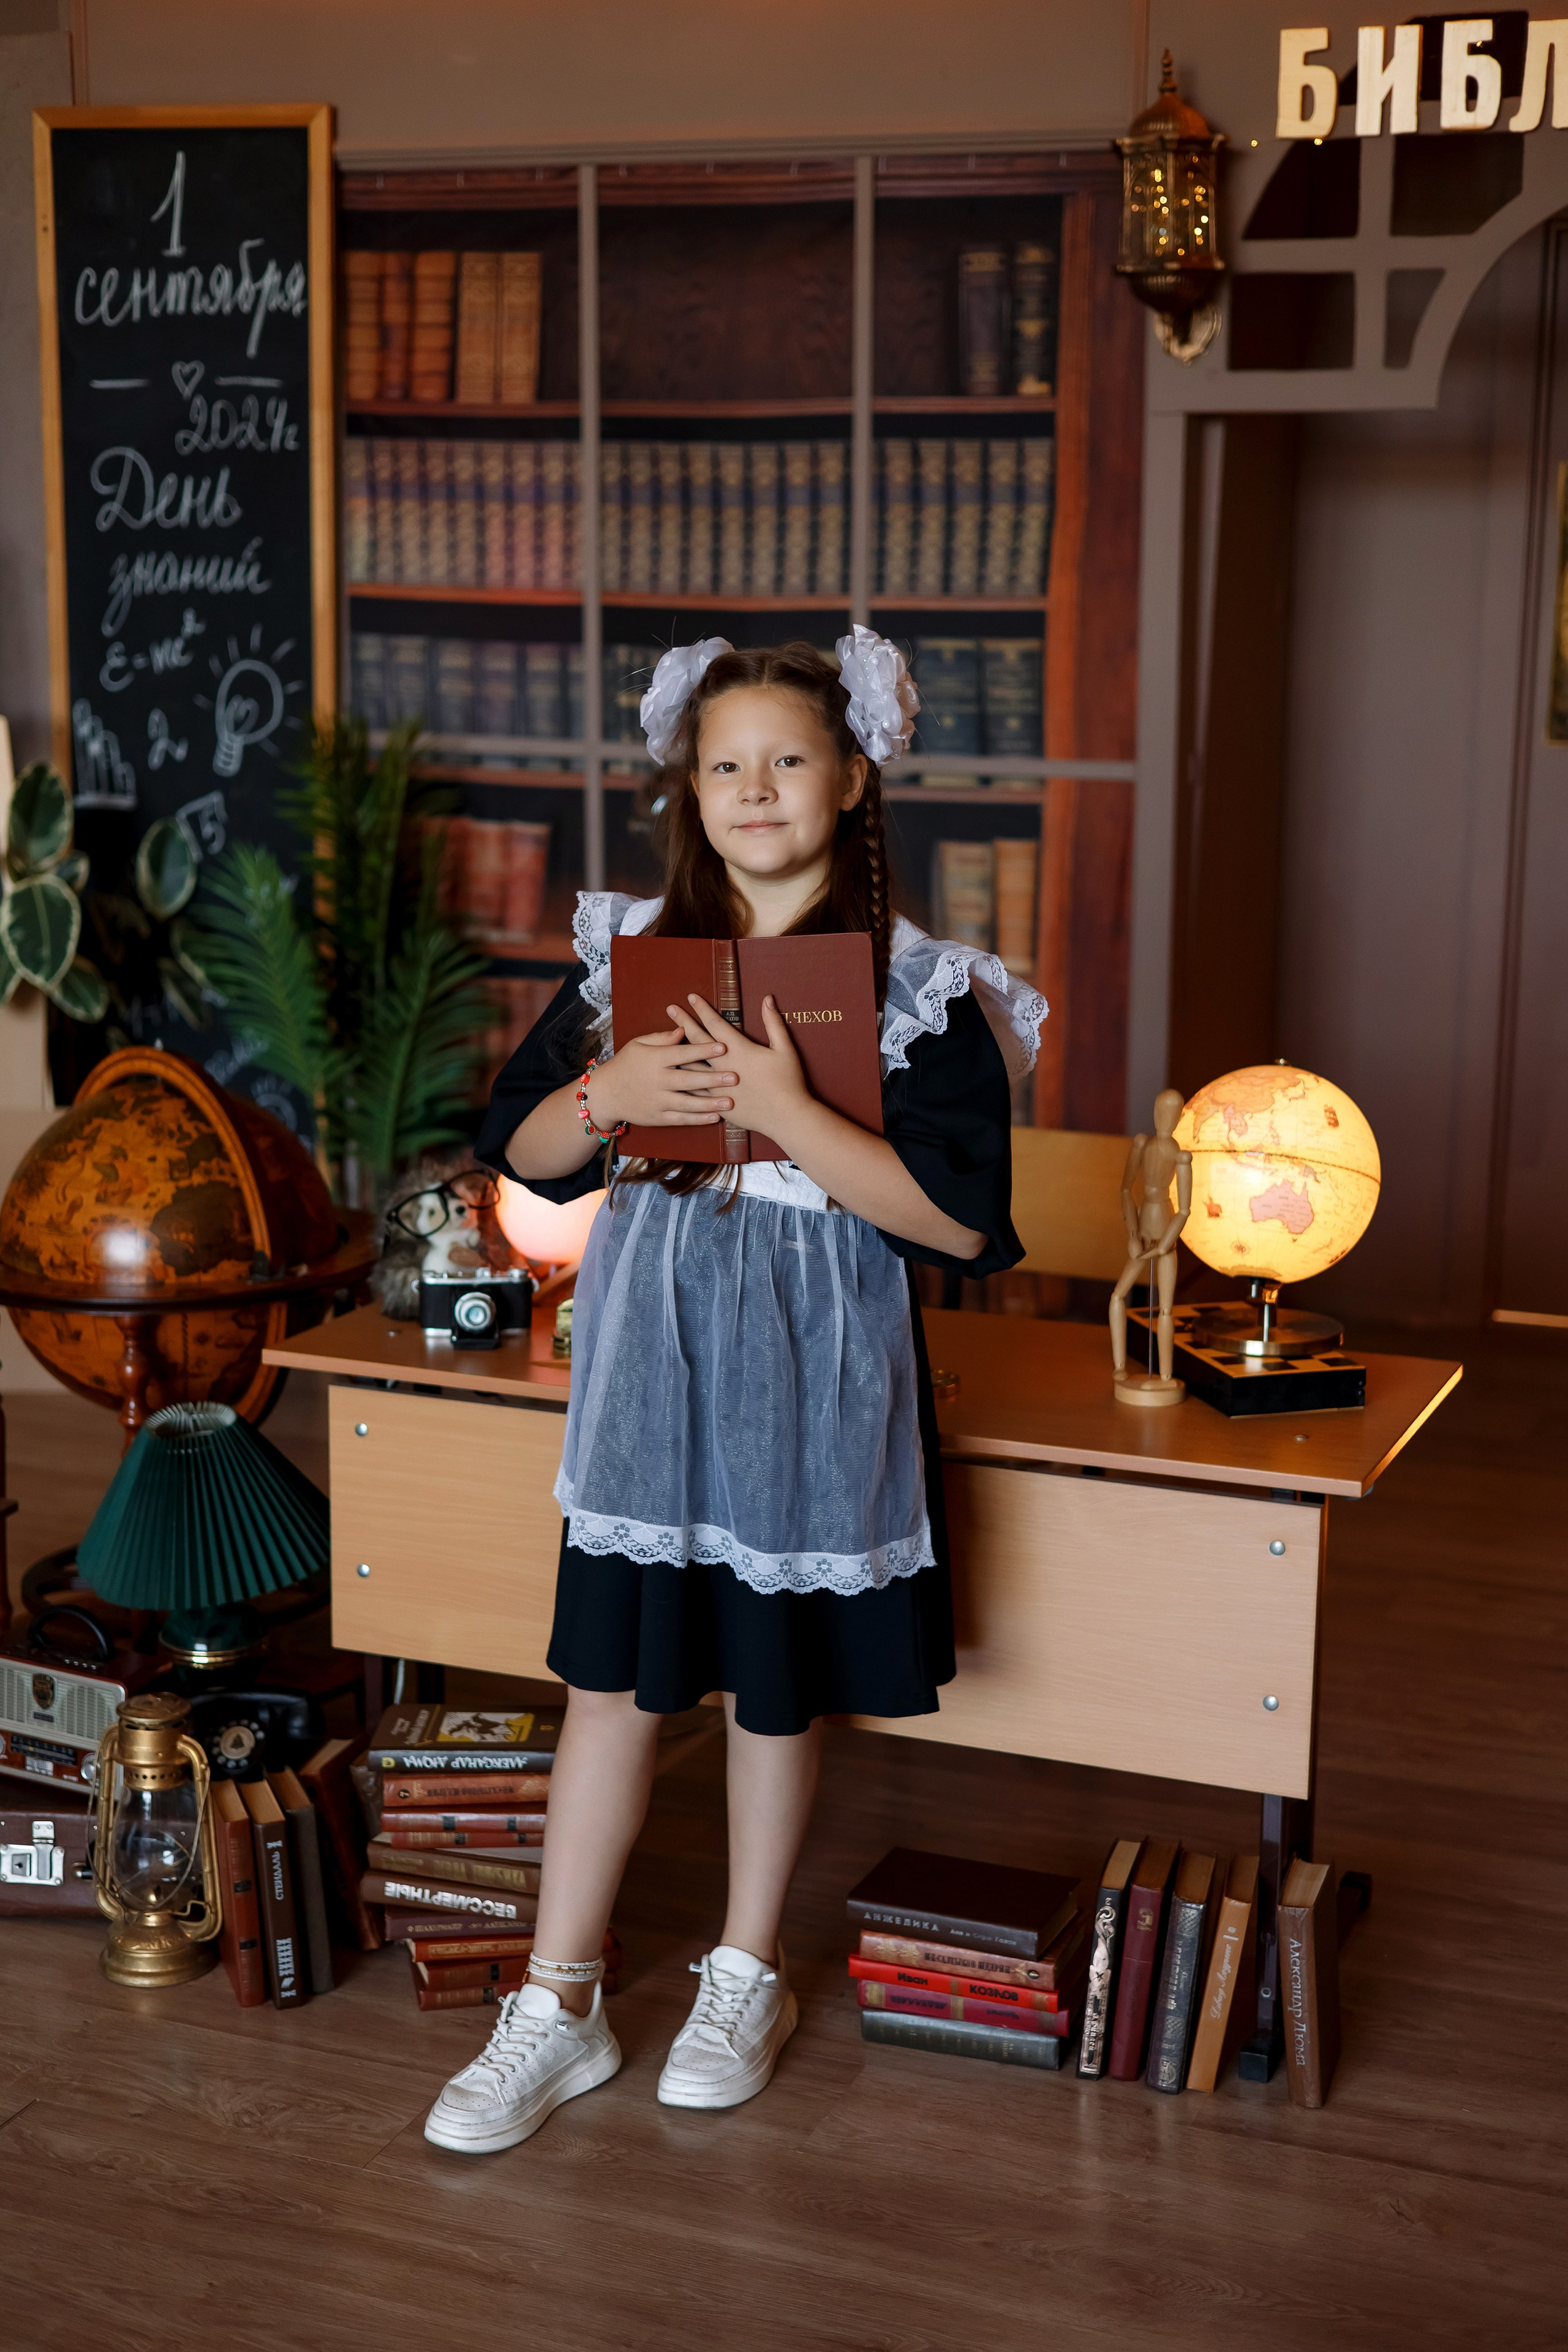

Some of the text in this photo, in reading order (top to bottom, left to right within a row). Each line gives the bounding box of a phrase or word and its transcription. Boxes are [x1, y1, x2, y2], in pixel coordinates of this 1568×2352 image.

[1276, 19, 1568, 139] БИБЛ
[151, 150, 186, 257] 1
[74, 238, 306, 359] сентября
[91, 446, 243, 532] День
[101, 536, 272, 637] знаний
[384, 1881, 518, 1920] БЕССМЕРТНЫЕ
[864, 1912, 940, 1932] АНЖЕЛИКА
[897, 1972, 1019, 2002] Иван КОЗЛОВ
